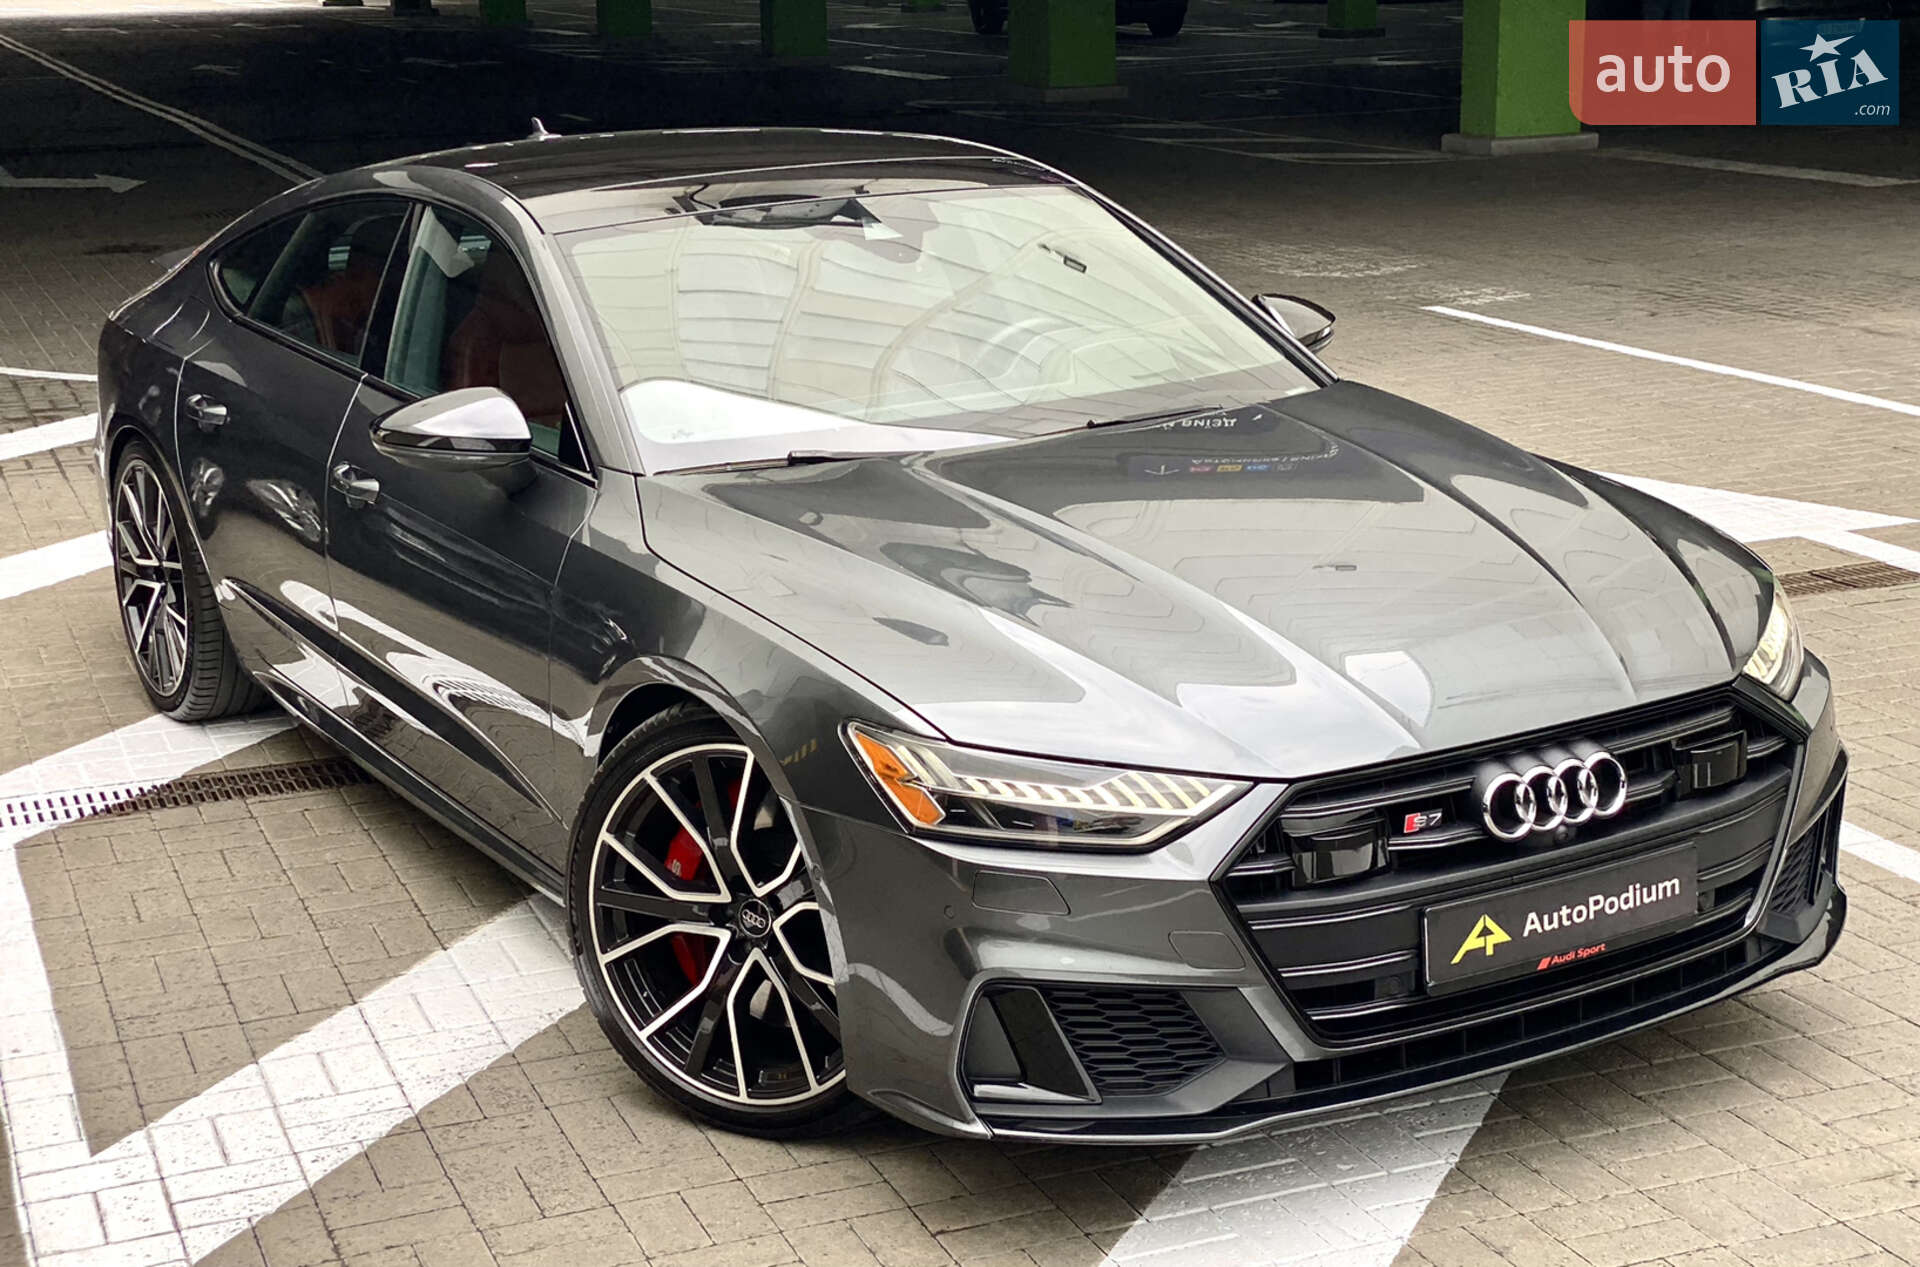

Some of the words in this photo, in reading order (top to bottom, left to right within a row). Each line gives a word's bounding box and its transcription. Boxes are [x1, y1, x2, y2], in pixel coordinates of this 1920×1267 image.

[1414, 812, 1442, 826] S7
[1522, 877, 1680, 937] AutoPodium
[1551, 951, 1575, 965] Audi
[1576, 943, 1606, 958] Sport
